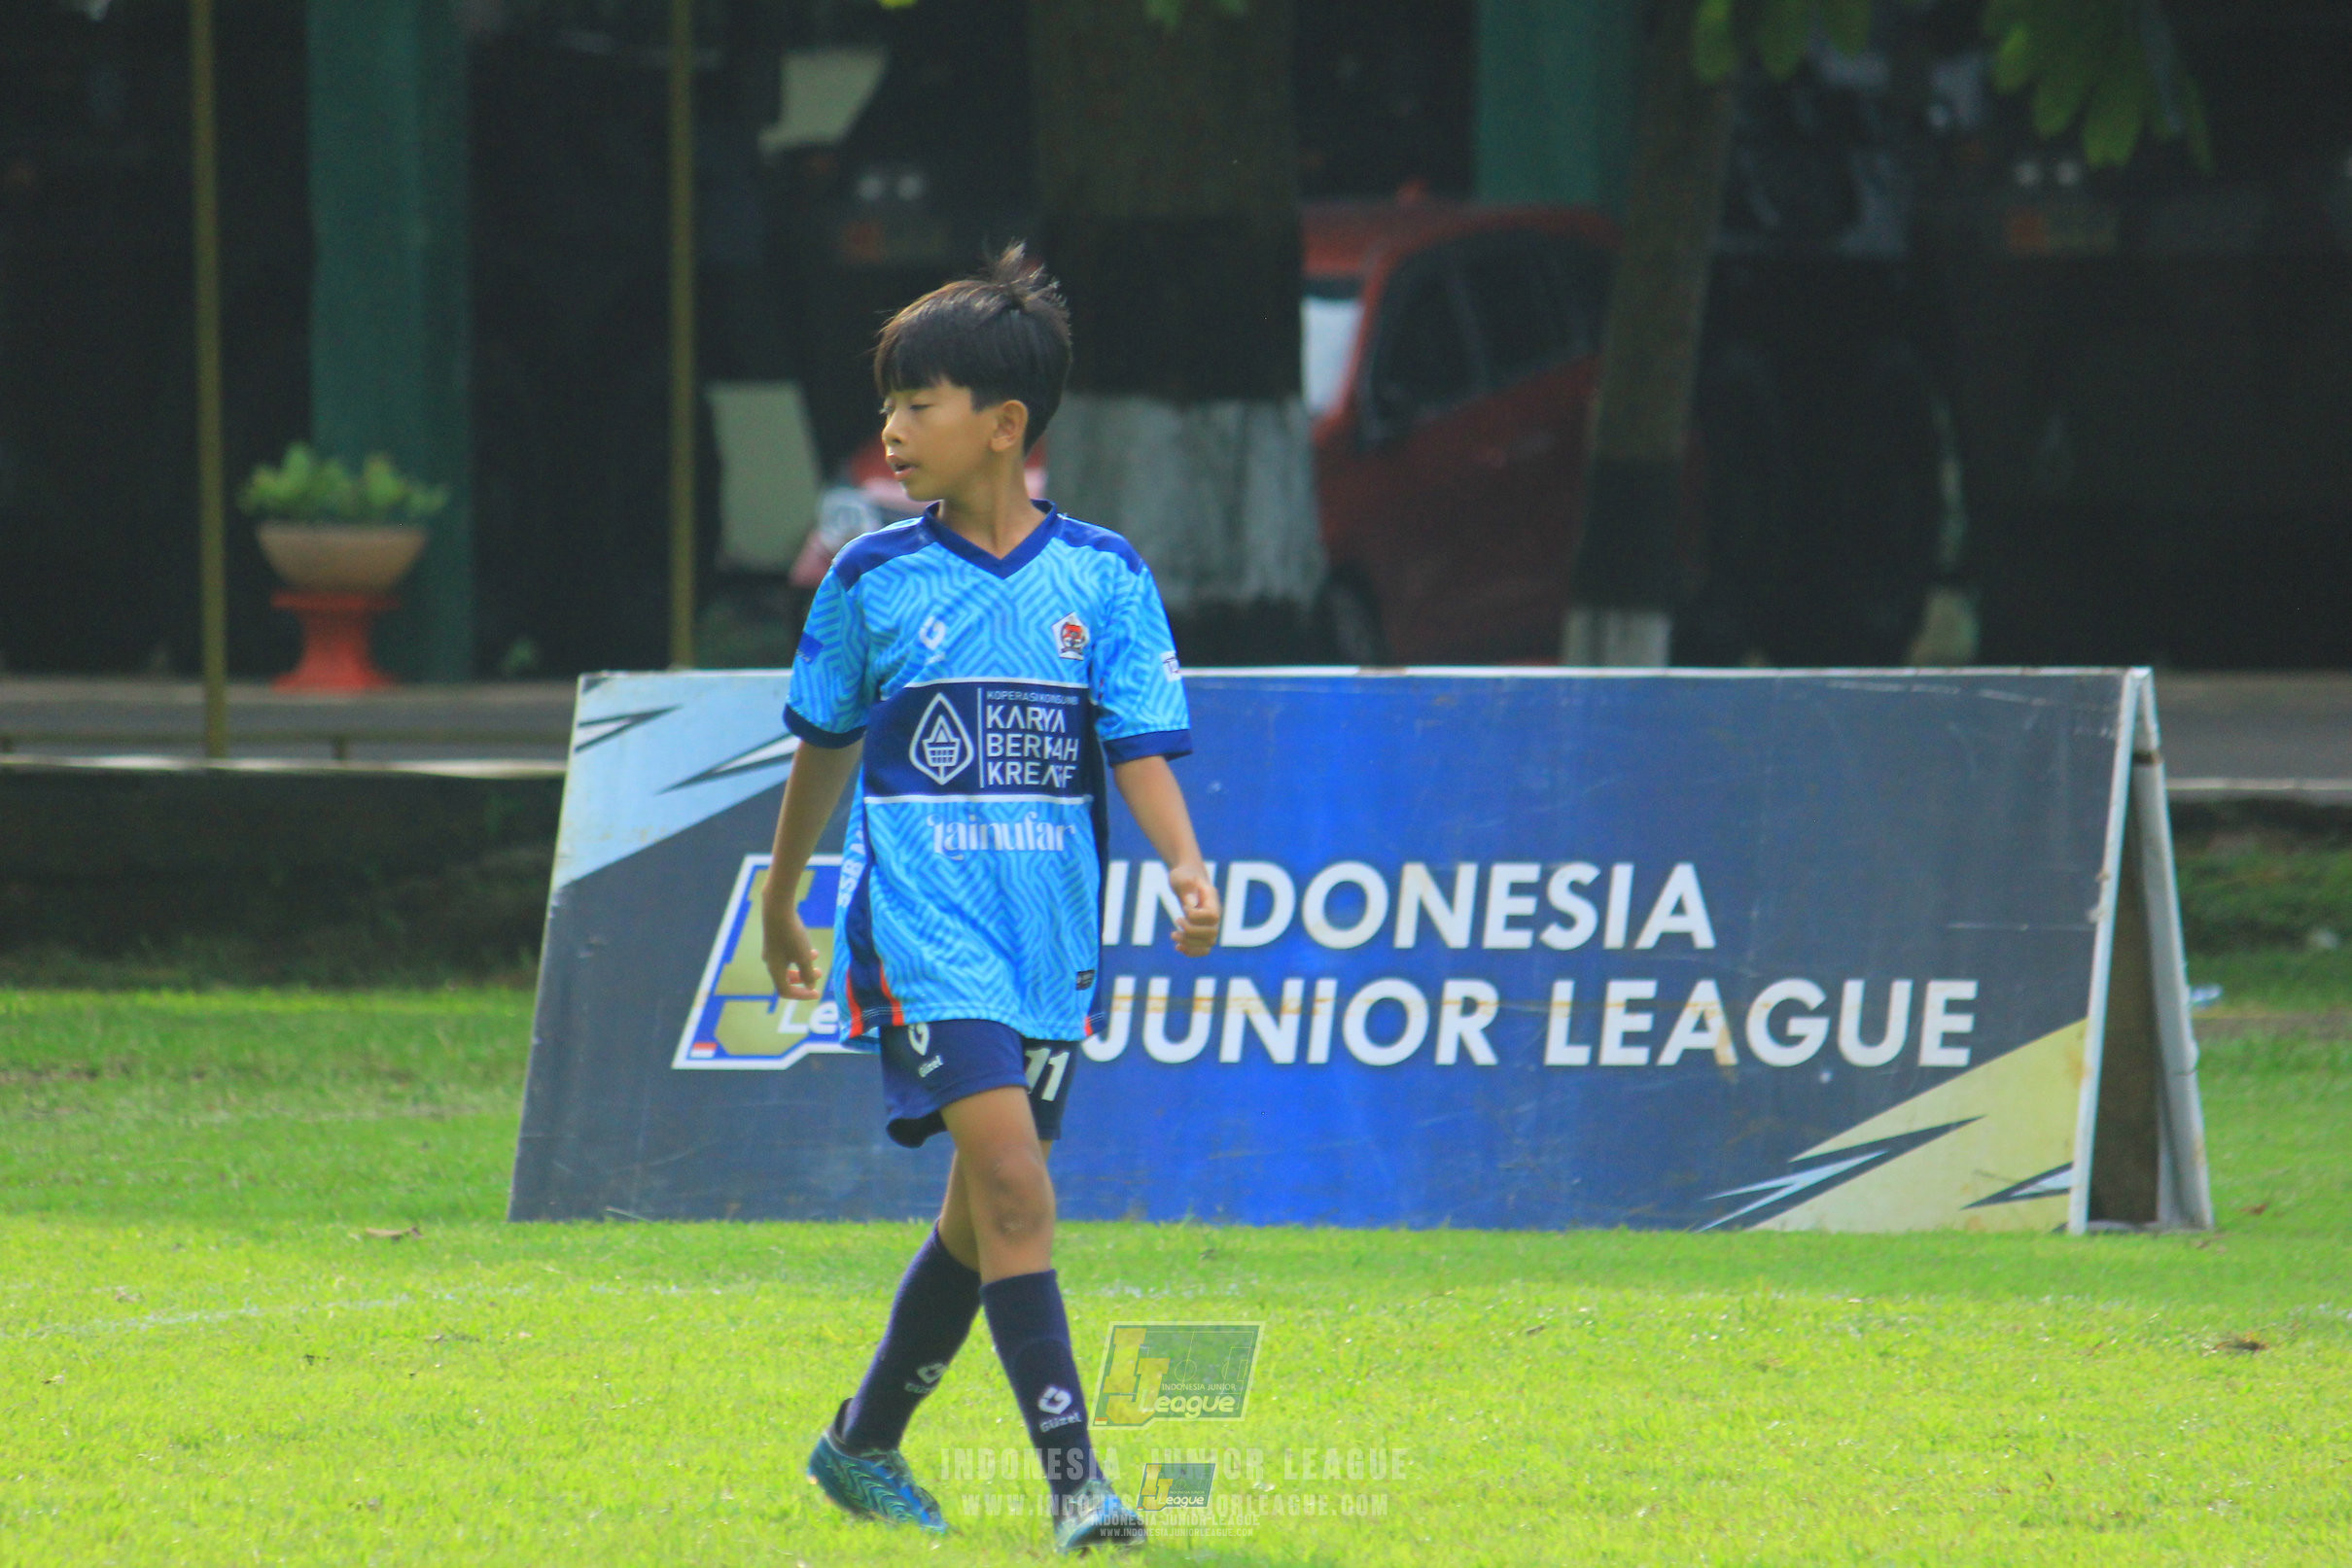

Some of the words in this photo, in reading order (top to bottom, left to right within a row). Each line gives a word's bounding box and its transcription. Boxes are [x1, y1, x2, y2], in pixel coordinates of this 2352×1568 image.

[986, 705, 1066, 733] KARYA
[1103, 859, 1716, 951] INDONESIA
[1081, 975, 1498, 1066] JUNIOR
[1544, 977, 1980, 1067] LEAGUE
[1024, 1047, 1071, 1101] 11
